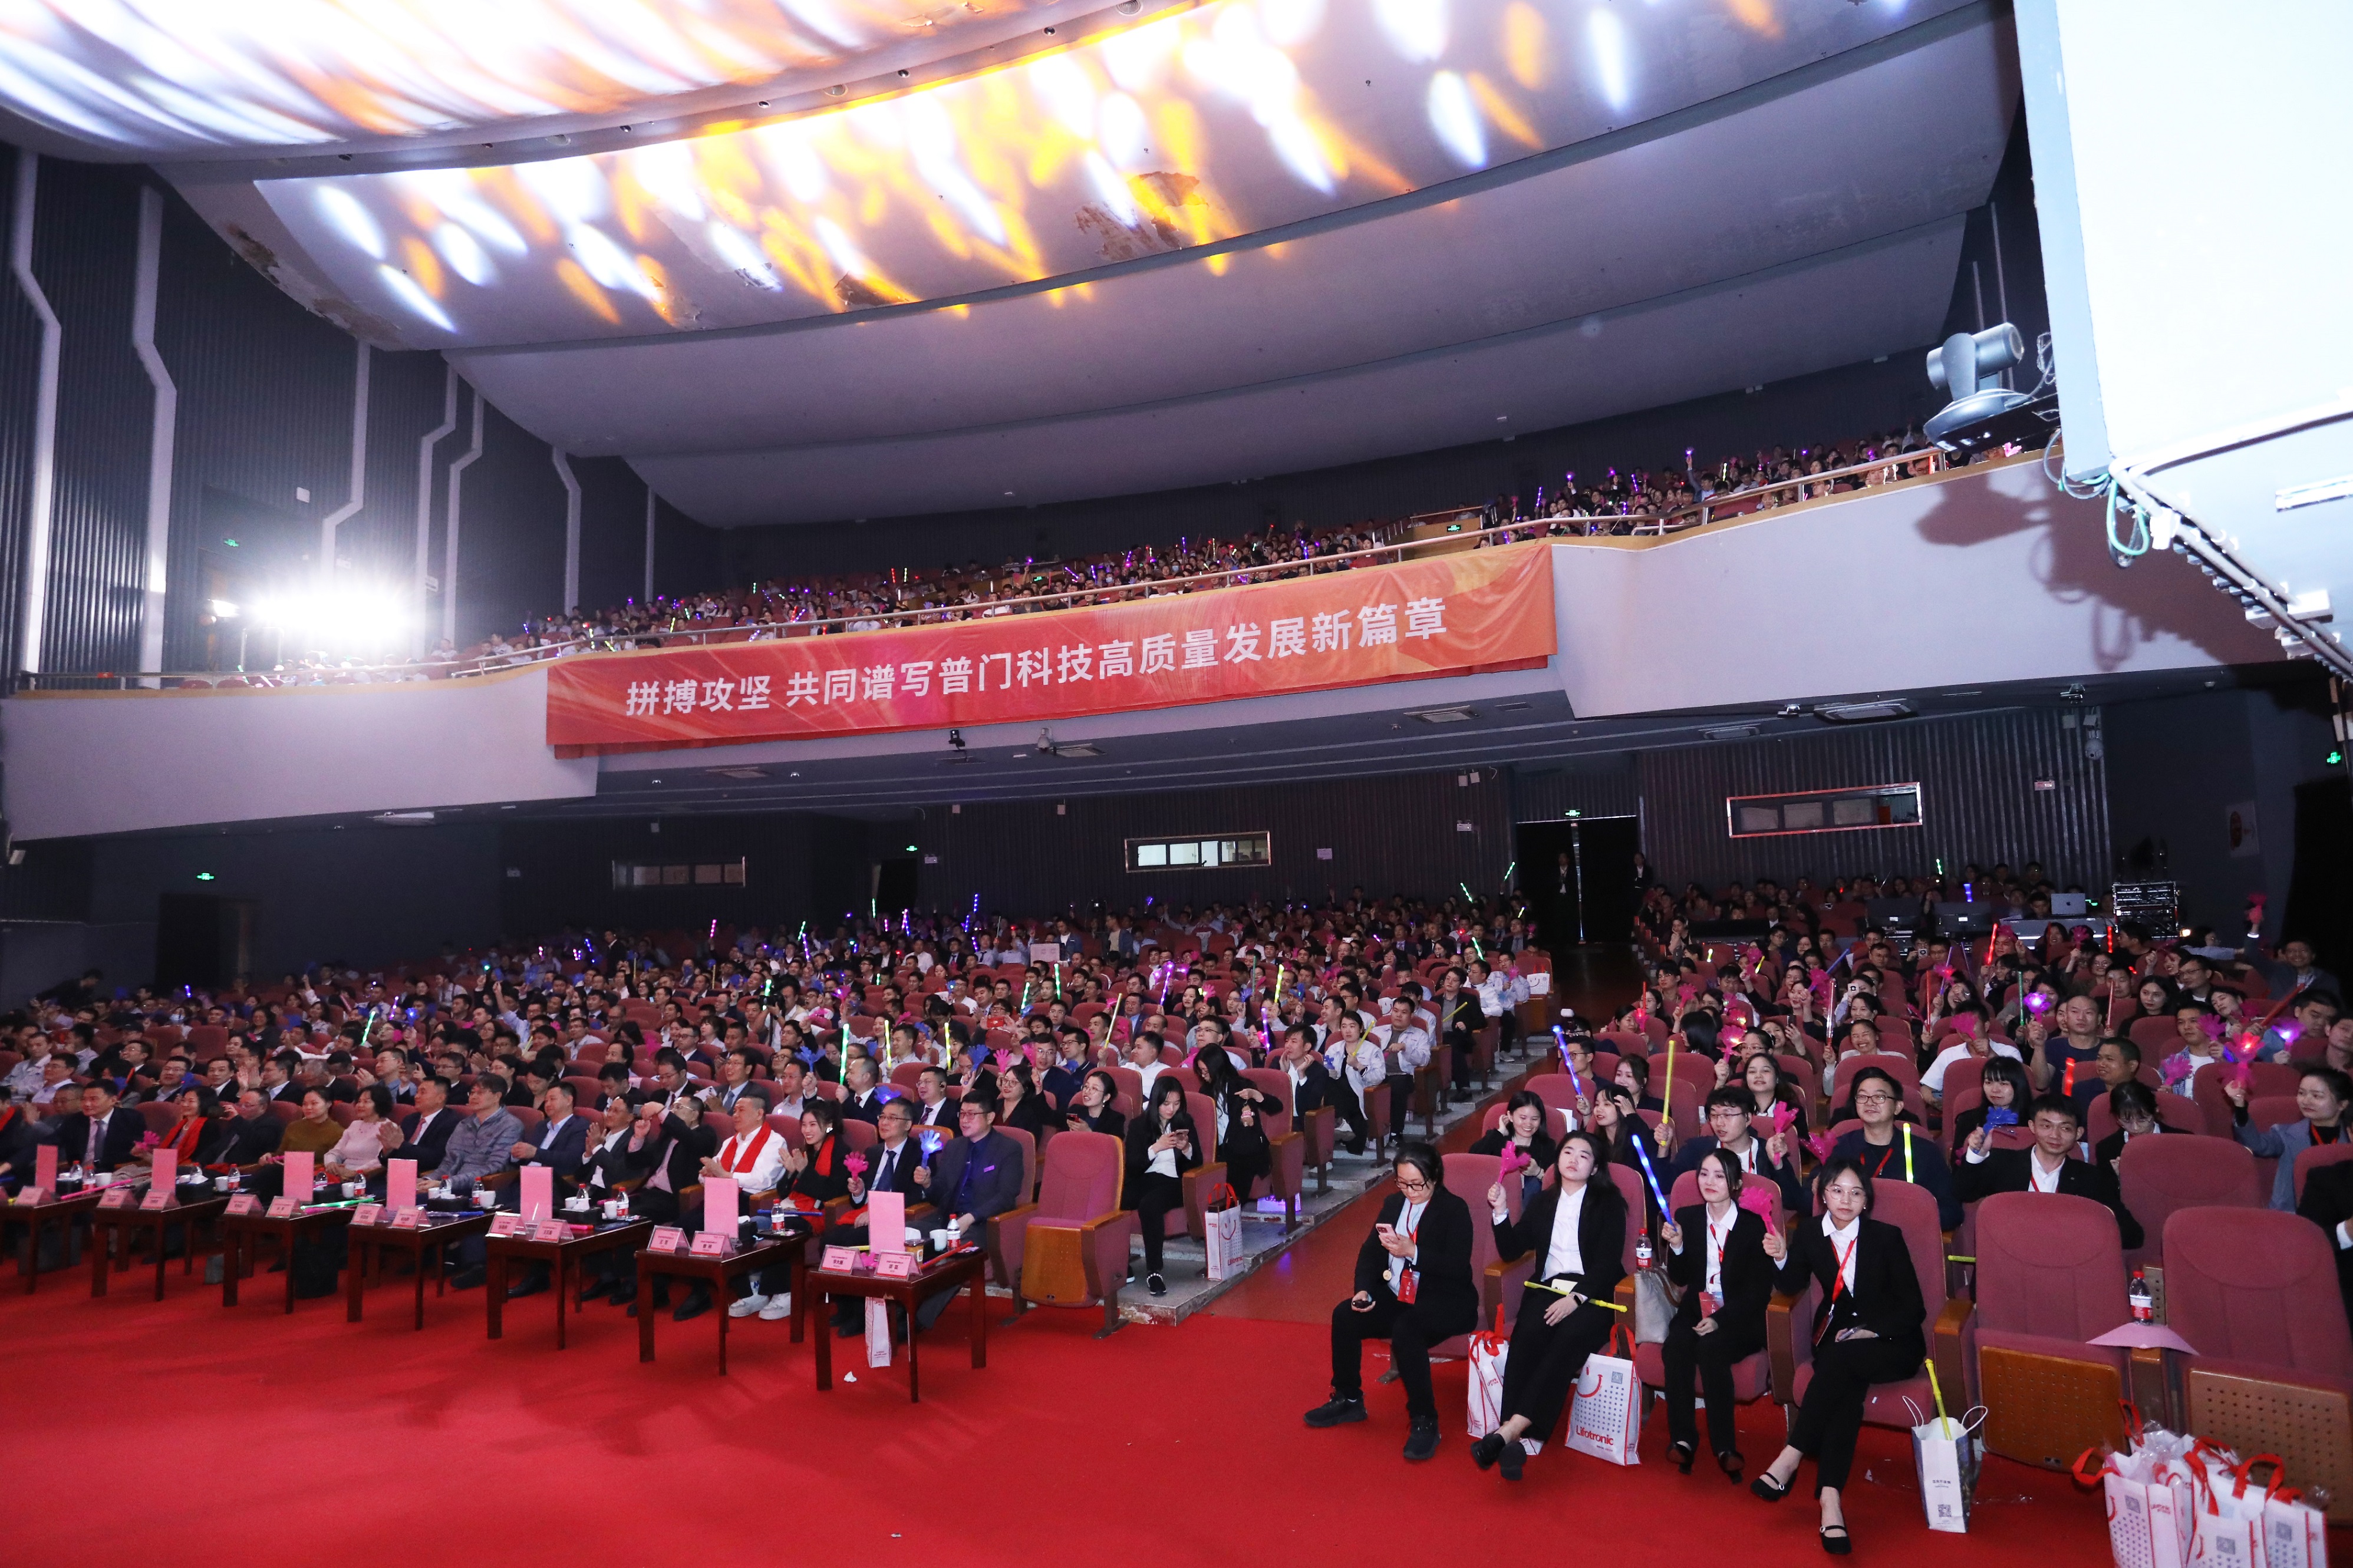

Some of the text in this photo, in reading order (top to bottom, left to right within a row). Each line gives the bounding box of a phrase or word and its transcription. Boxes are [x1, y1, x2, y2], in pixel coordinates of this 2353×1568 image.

[627, 597, 1446, 716] 拼搏攻坚 共同谱写普门科技高质量发展新篇章
[1576, 1425, 1614, 1445] Lifotronic
